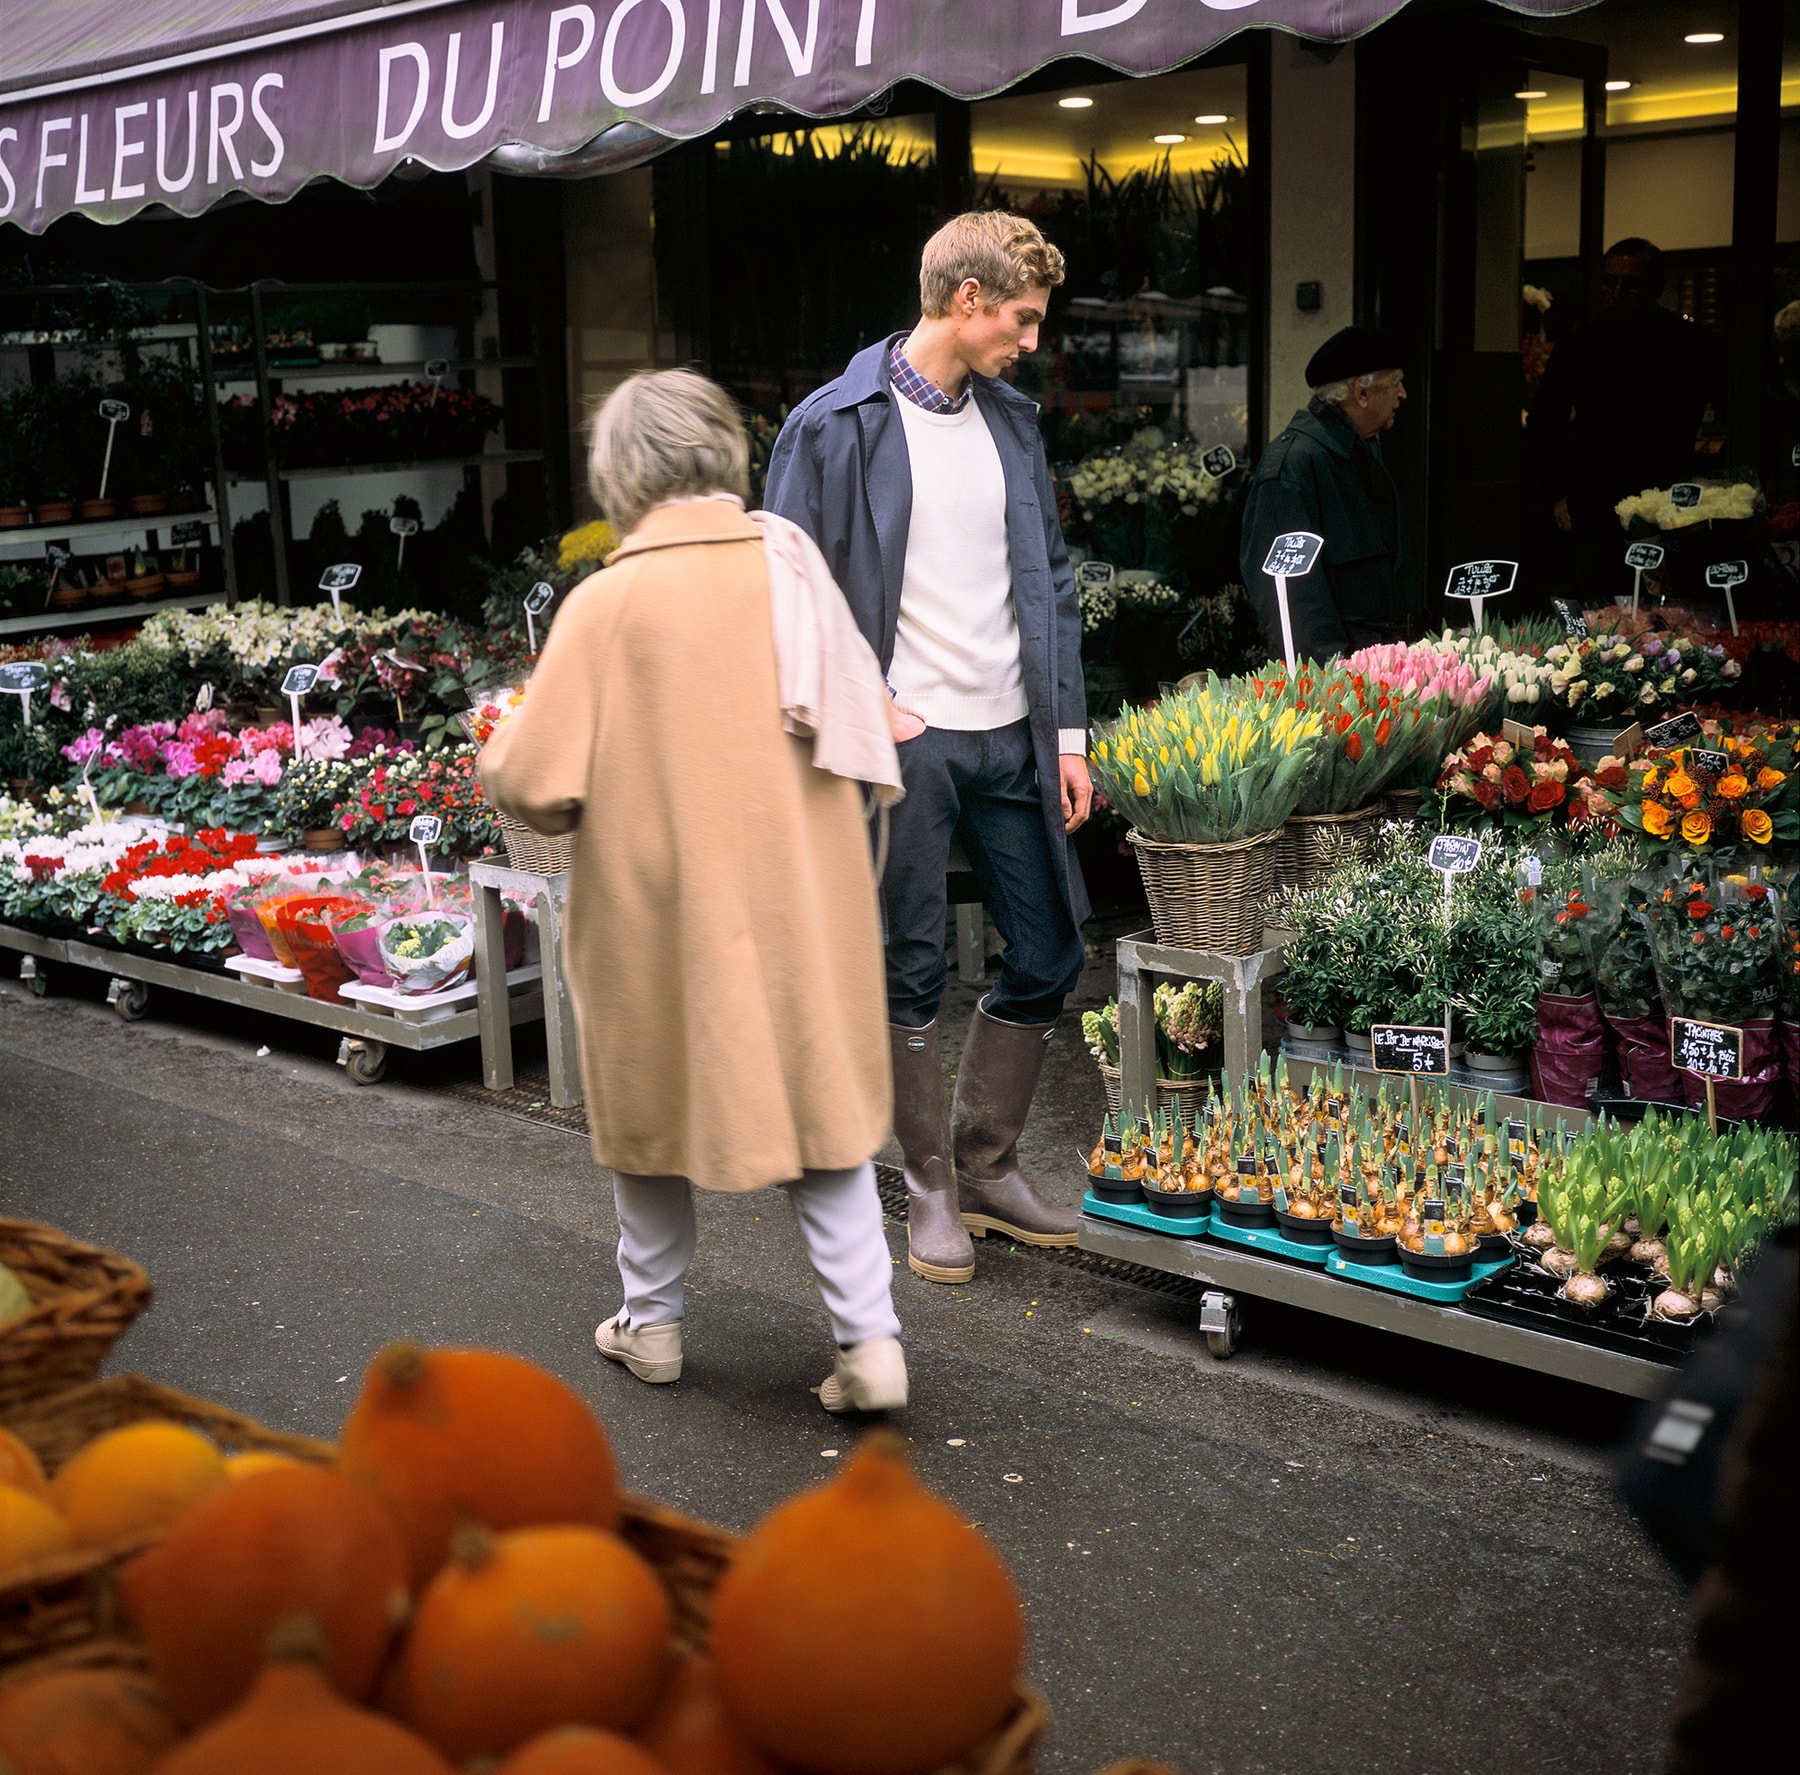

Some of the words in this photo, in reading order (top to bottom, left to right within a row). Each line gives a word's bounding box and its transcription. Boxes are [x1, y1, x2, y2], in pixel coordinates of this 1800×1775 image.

[35, 73, 285, 208] FLEURS
[373, 21, 504, 154] DU
[1374, 1032, 1385, 1045] LE
[1398, 1033, 1412, 1047] DE
[1721, 1062, 1730, 1076] 5
